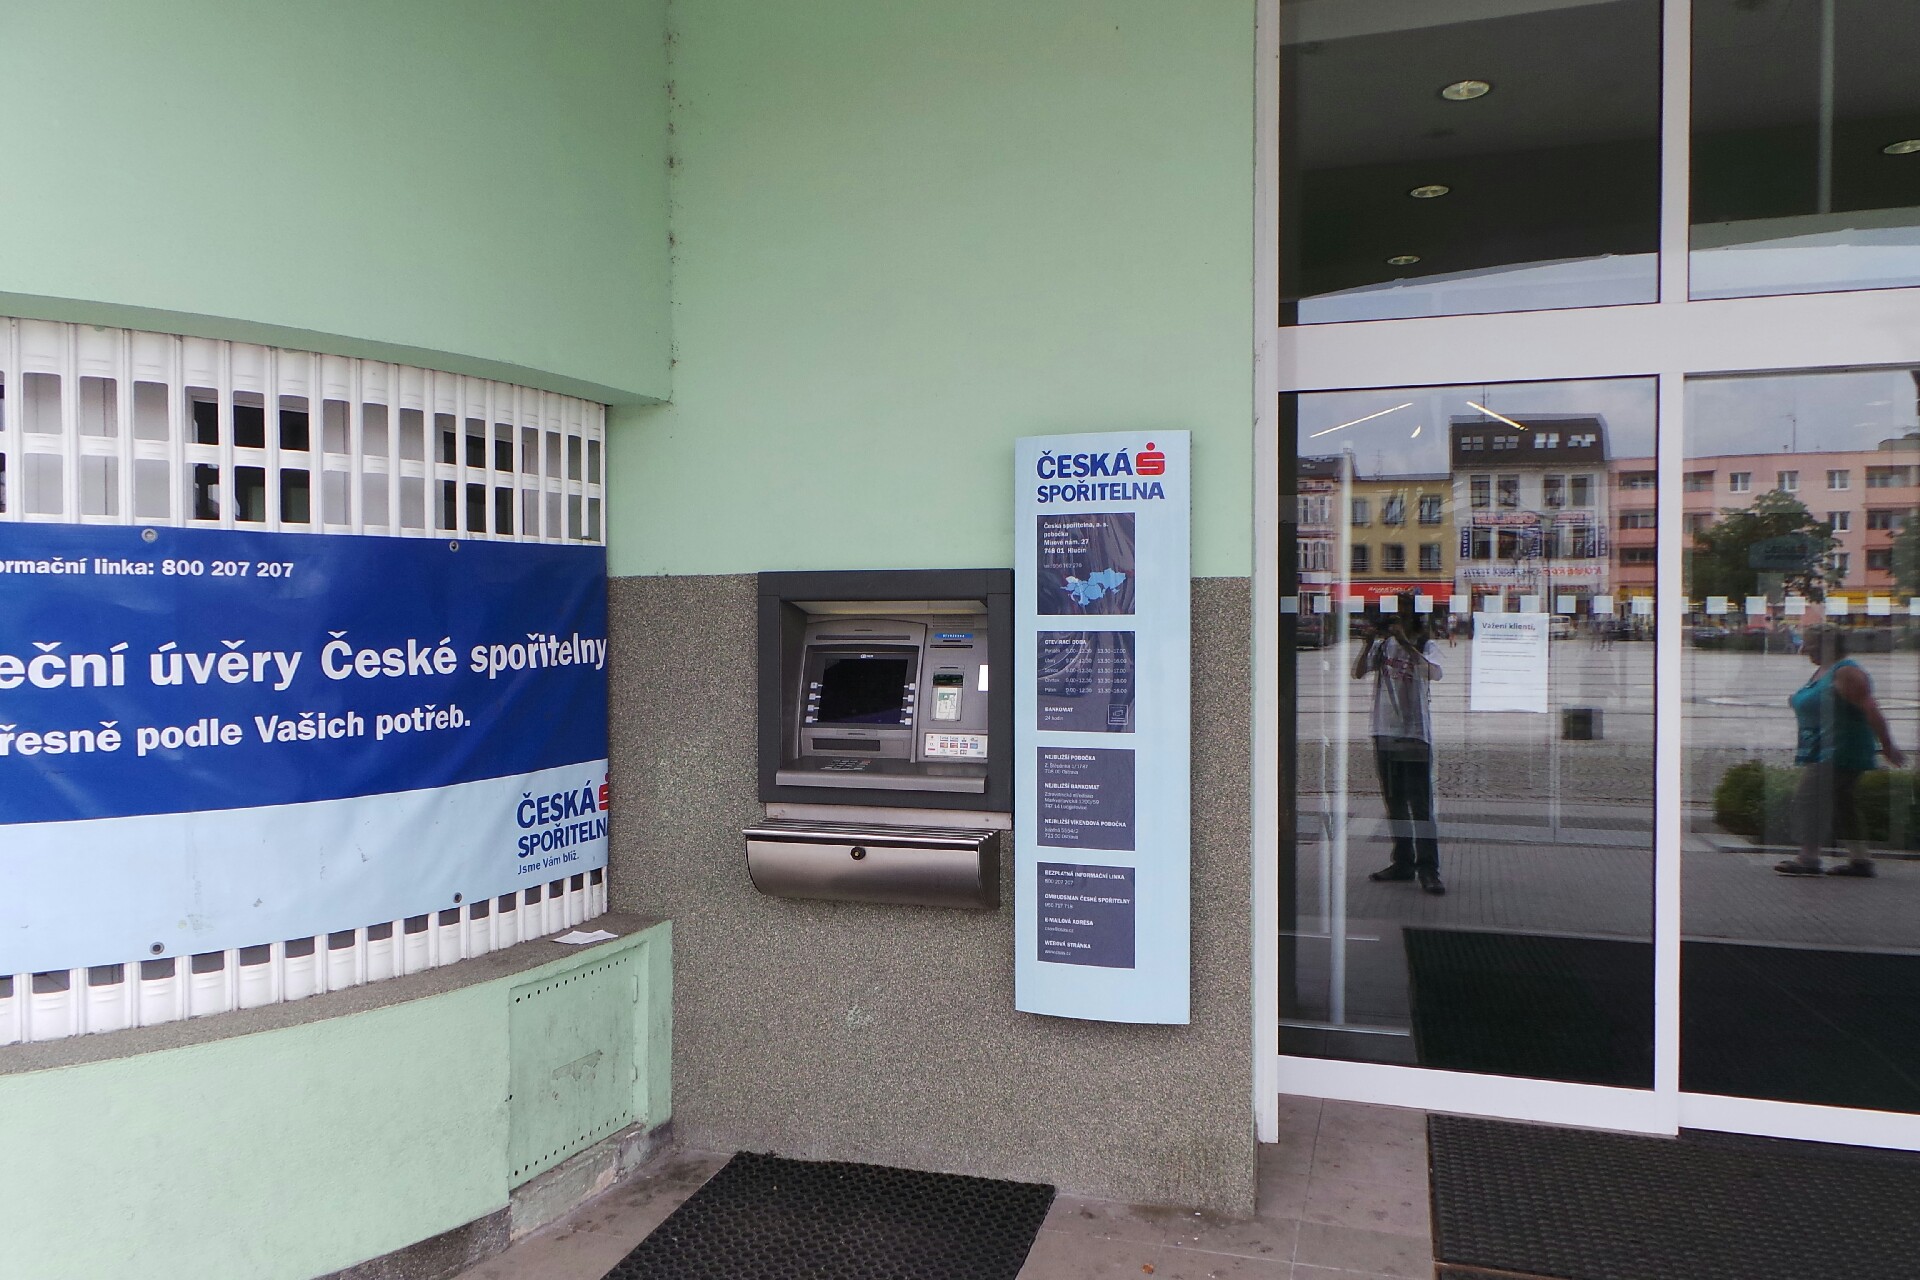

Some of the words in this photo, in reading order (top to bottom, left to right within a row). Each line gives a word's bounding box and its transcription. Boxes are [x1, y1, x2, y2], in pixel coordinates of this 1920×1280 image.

[1036, 448, 1133, 480] ČESKÁ
[1037, 479, 1165, 503] SPOŘITELNA
[94, 558, 154, 575] linka:
[162, 559, 204, 576] 800
[211, 560, 250, 577] 207
[257, 562, 294, 577] 207
[0, 641, 129, 689] eční
[150, 640, 303, 691] úvěry
[321, 630, 457, 680] České
[470, 632, 607, 680] spořitelny
[137, 718, 243, 757] podle
[254, 711, 364, 743] Vašich
[376, 704, 471, 740] potřeb.
[517, 780, 597, 828] ČESKÁ
[518, 817, 608, 858] SPOŘITELN
[518, 863, 541, 875] Jsme
[543, 856, 560, 868] Vám
[563, 850, 580, 863] blíž.
